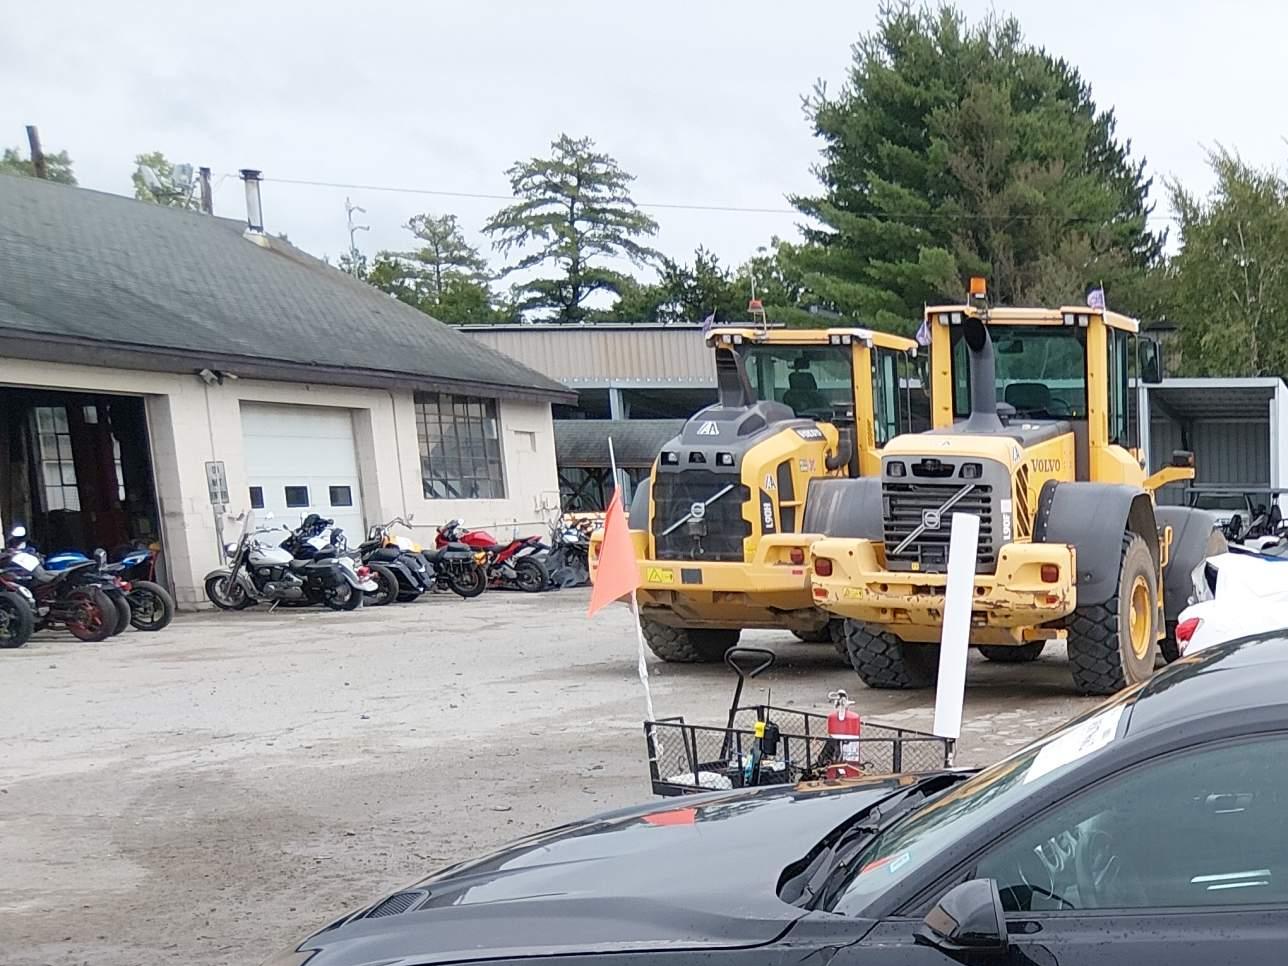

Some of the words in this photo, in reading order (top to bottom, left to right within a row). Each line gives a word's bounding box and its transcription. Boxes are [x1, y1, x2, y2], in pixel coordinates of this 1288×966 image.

[1031, 458, 1061, 473] VOLVO
[762, 502, 774, 529] L90H
[1002, 514, 1011, 541] L90F
